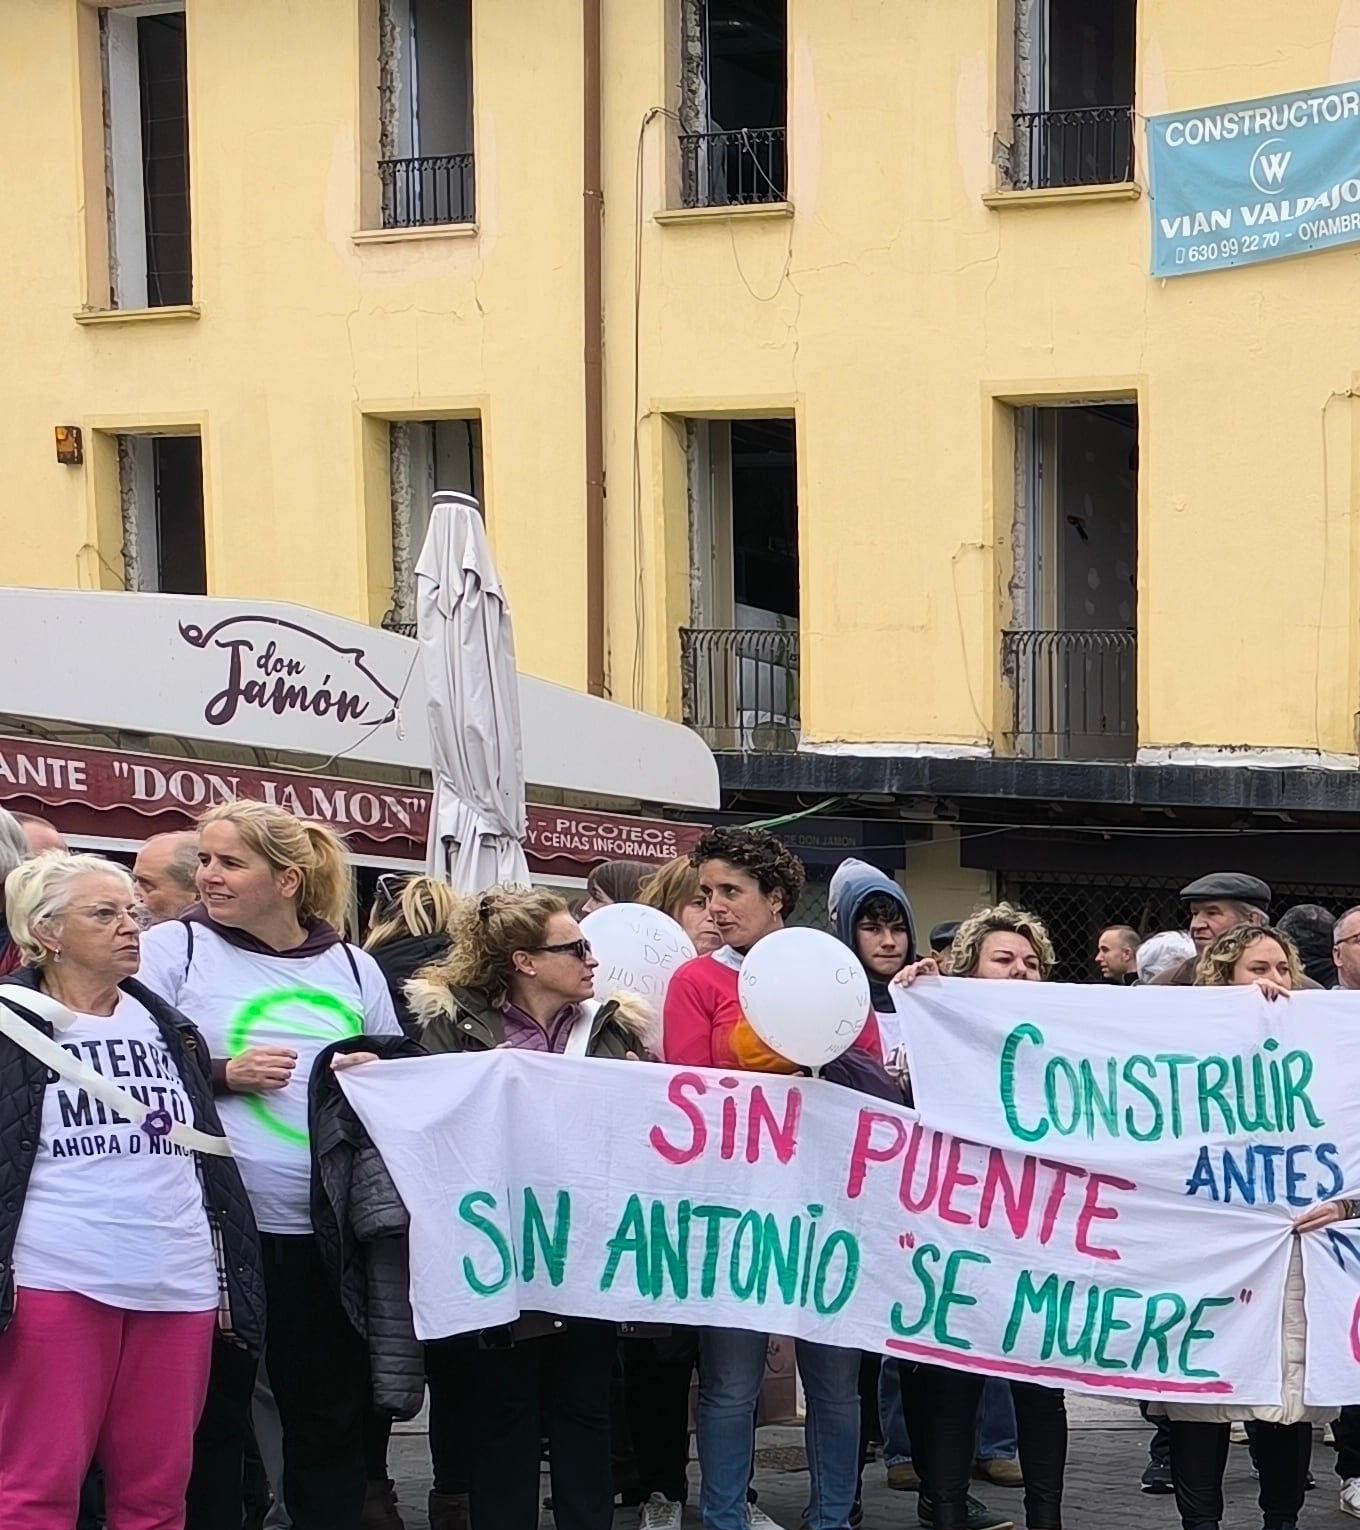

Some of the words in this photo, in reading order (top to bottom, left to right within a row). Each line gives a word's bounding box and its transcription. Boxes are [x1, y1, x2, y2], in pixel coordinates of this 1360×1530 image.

[1160, 208, 1232, 239] VIAN
[1188, 241, 1218, 262] 630
[1221, 239, 1239, 258] 99
[1241, 235, 1260, 254] 22
[1262, 231, 1279, 248] 70
[257, 640, 306, 676] don
[204, 639, 370, 725] Jamón
[528, 830, 537, 844] Y
[541, 832, 589, 850] CENAS
[593, 837, 677, 858] INFORMALES
[556, 818, 676, 844] PICOTEOS
[644, 944, 673, 970] DE
[999, 1021, 1324, 1143] CONSTRUIR
[53, 1135, 121, 1157] AHORA
[130, 1135, 141, 1154] O
[649, 1071, 801, 1166] SIN
[848, 1107, 1136, 1260] PUENTE
[1185, 1142, 1344, 1204] ANTES
[602, 1203, 860, 1315] ANTONIO
